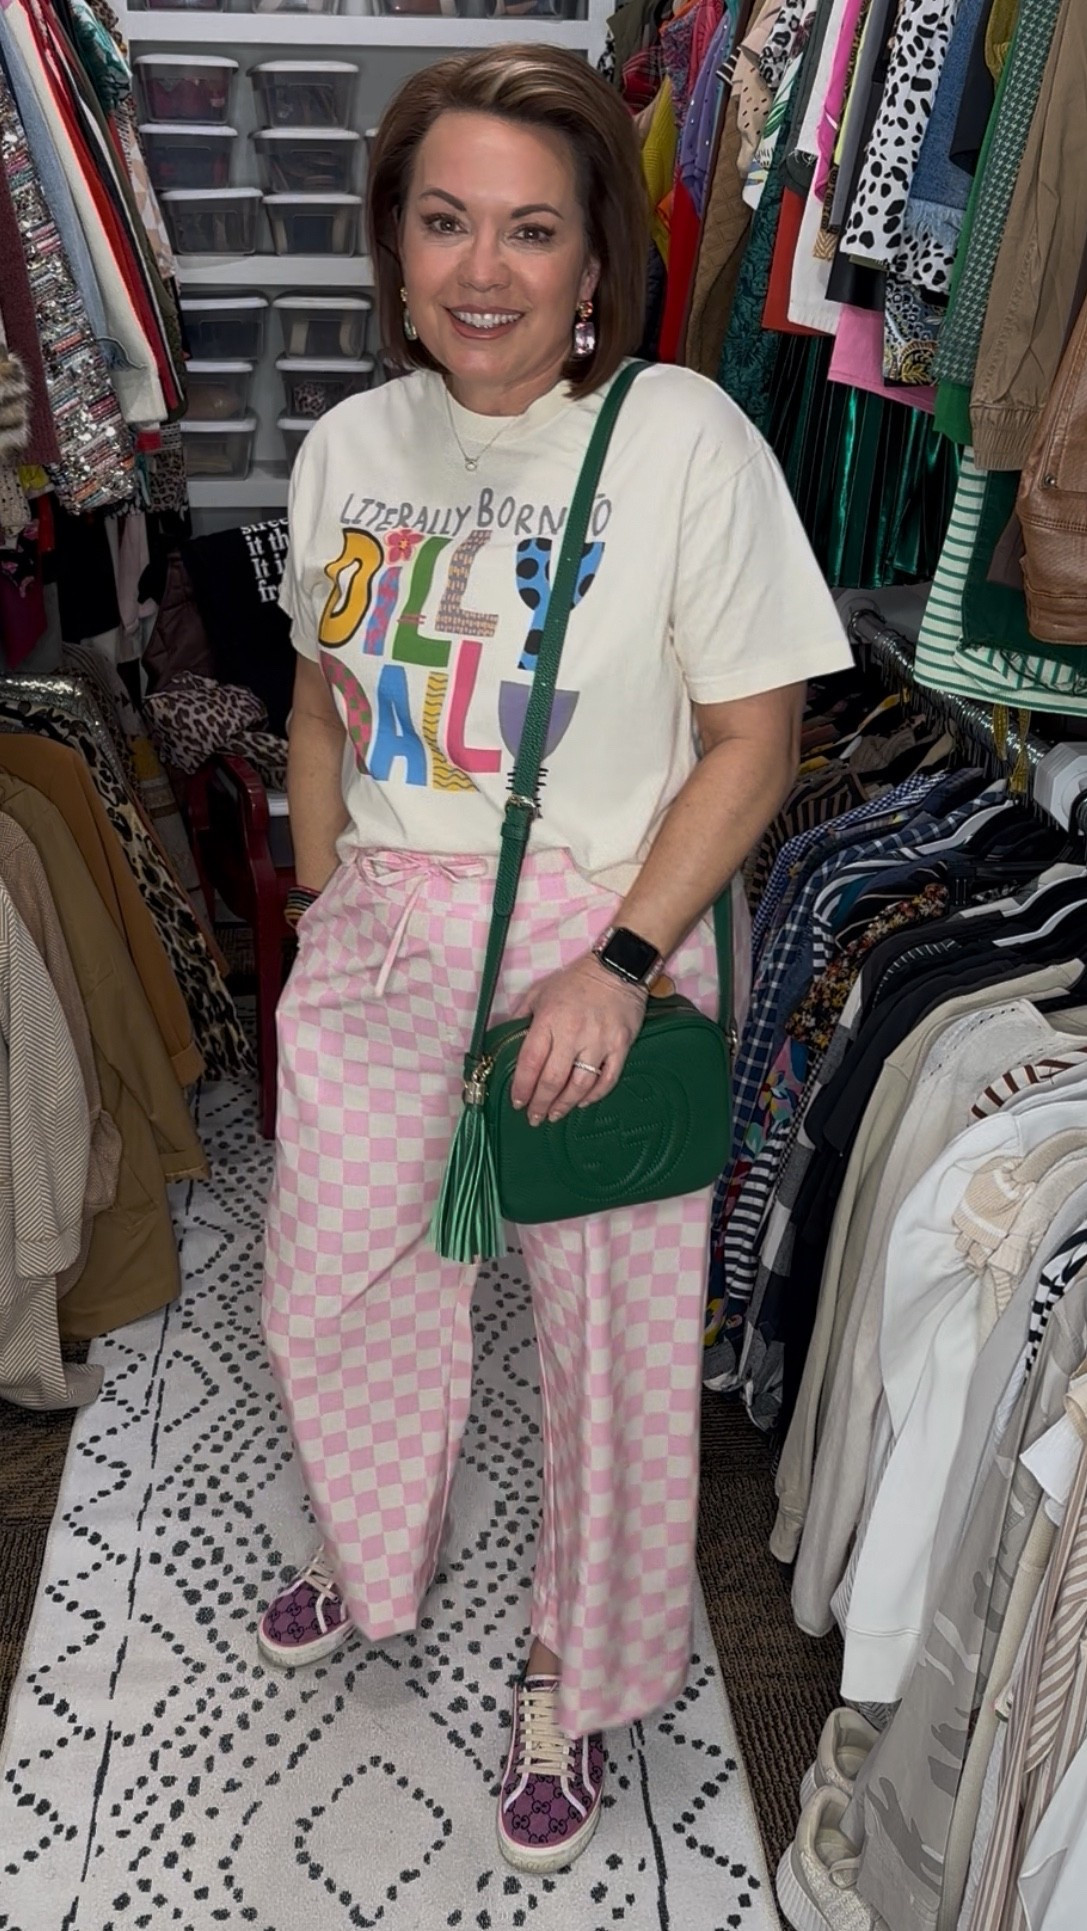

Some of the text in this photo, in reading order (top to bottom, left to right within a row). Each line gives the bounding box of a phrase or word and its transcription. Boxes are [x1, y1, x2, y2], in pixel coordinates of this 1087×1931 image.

[340, 493, 471, 536] LITERALLY
[477, 487, 567, 535] BORN
[245, 535, 264, 557] it
